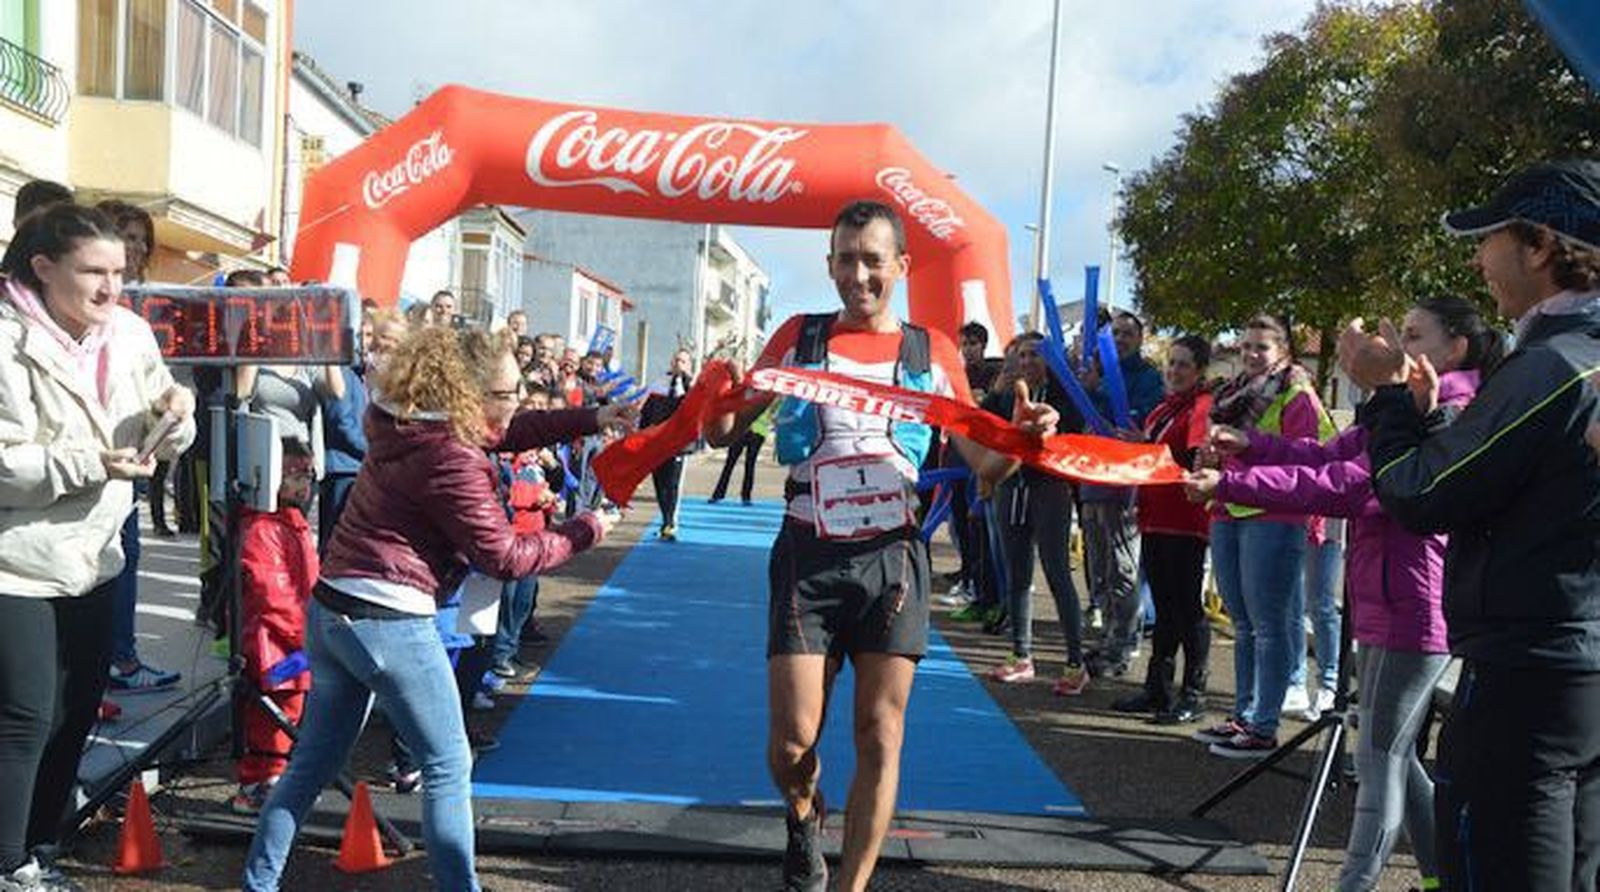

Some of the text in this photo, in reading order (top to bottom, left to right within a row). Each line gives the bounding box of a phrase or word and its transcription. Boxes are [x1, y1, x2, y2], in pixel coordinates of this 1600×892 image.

[363, 130, 452, 208] Coca-Cola
[525, 110, 808, 203] Coca-Cola
[875, 167, 965, 240] Coca-Cola
[857, 468, 866, 485] 1
